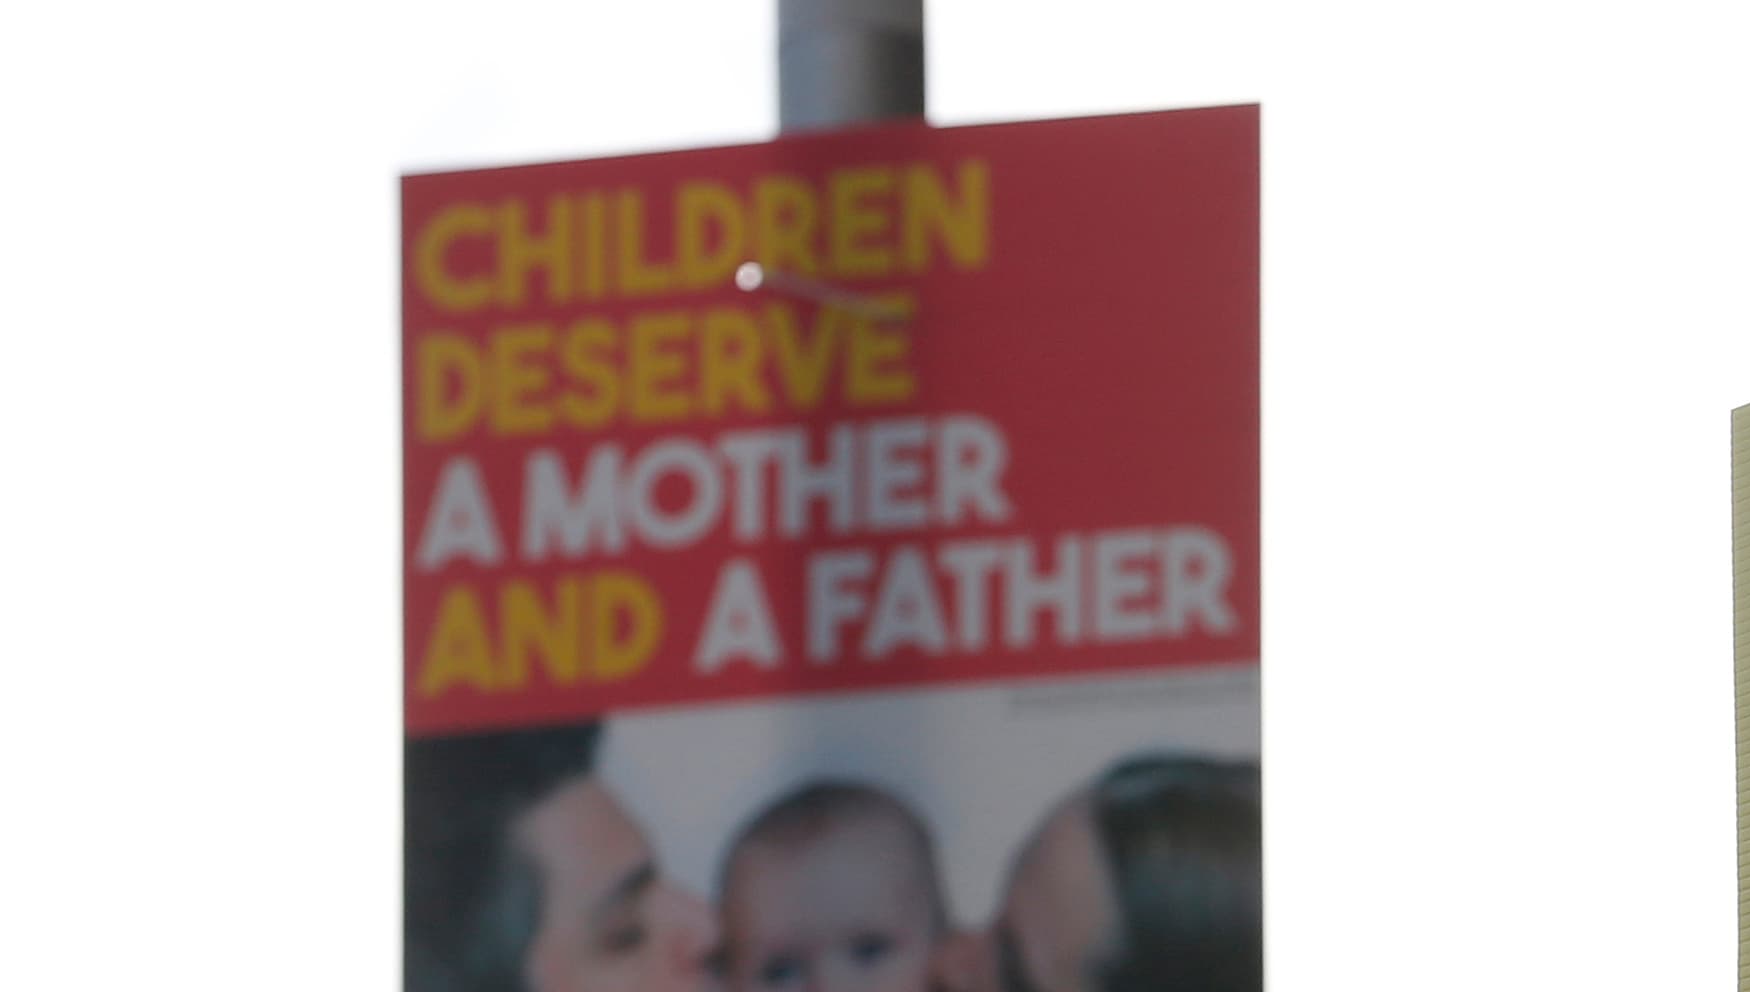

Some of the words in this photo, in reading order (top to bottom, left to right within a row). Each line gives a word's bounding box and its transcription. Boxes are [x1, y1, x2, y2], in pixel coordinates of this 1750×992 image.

[414, 158, 991, 310] CHILDREN
[414, 293, 917, 442] DESERVE
[416, 457, 504, 570] A
[520, 414, 1013, 562] MOTHER
[417, 574, 664, 698] AND
[693, 560, 783, 674] A
[806, 526, 1237, 664] FATHER
